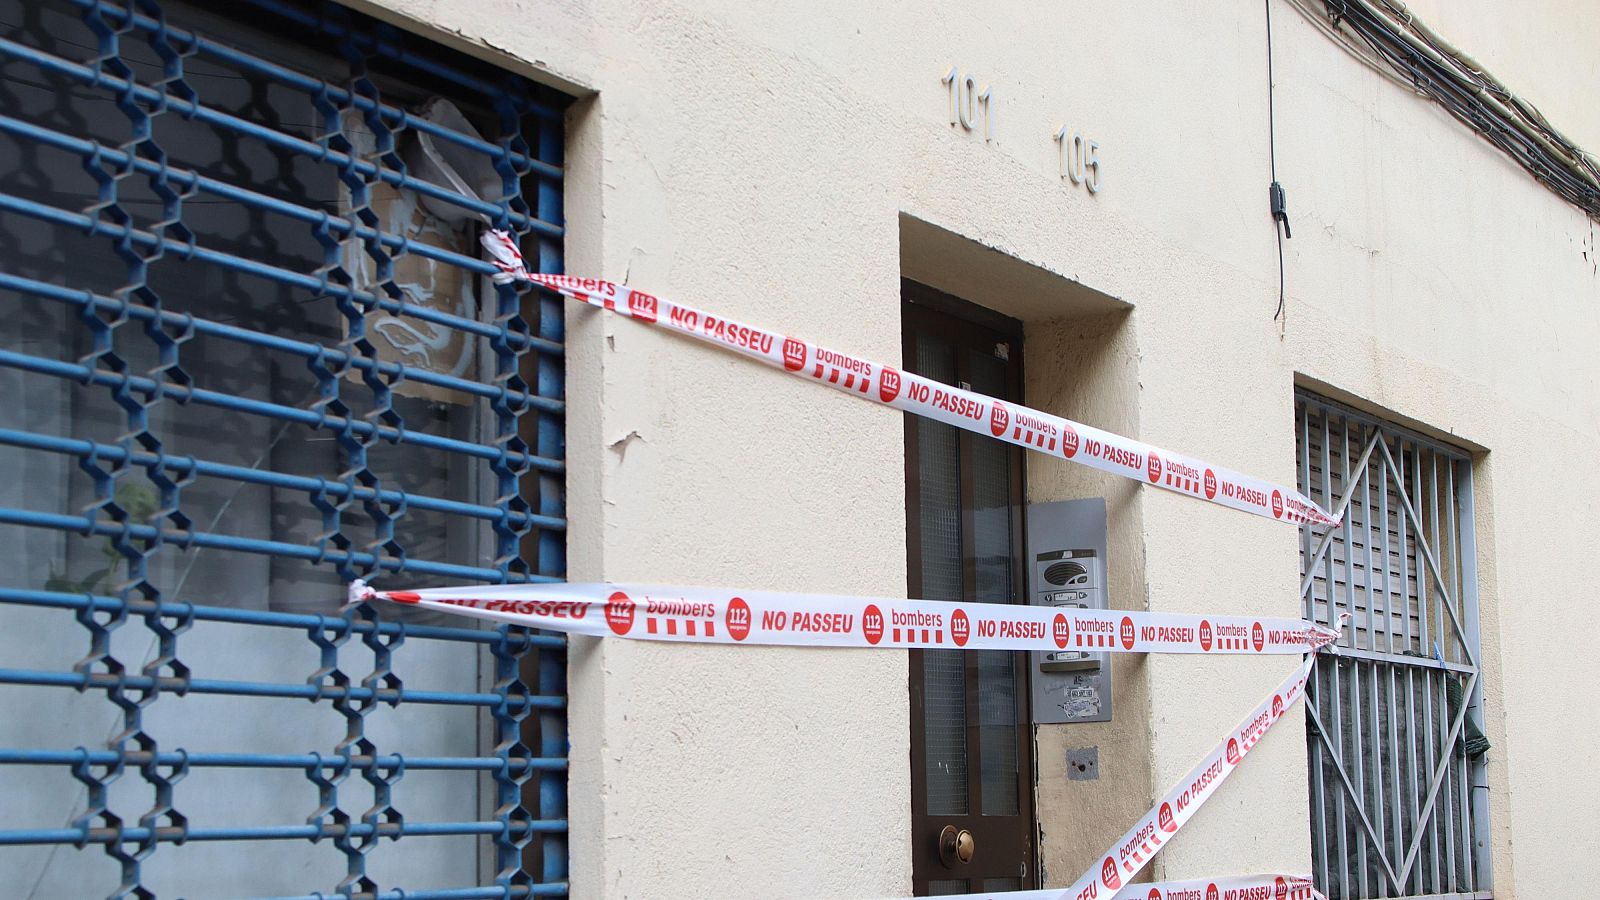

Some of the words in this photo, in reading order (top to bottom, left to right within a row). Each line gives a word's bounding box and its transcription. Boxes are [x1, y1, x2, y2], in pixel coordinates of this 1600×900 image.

[941, 65, 993, 142] 101
[1053, 124, 1104, 195] 105
[632, 293, 654, 314] 112
[670, 305, 698, 332] NO
[703, 322, 774, 354] PASSEU
[786, 341, 804, 360] 112
[816, 347, 872, 376] bombers
[882, 372, 898, 390] 112
[907, 381, 930, 403] NO
[932, 388, 985, 421] PASSEU
[993, 408, 1007, 424] 112
[1015, 410, 1057, 436] bombers
[1065, 431, 1077, 445] 112
[1084, 439, 1101, 457] NO
[1102, 443, 1143, 470] PASSEU
[1166, 461, 1199, 480] bombers
[1221, 480, 1234, 498] NO
[1236, 486, 1268, 508] PASSEU
[609, 602, 631, 617] 112
[646, 596, 716, 618] bombers
[729, 607, 748, 625] 112
[762, 610, 787, 631] NO
[791, 611, 854, 633] PASSEU
[866, 614, 881, 629] 112
[892, 608, 943, 627] bombers
[953, 618, 967, 632] 112
[977, 620, 996, 638] NO
[999, 620, 1047, 639] PASSEU
[1055, 622, 1067, 635] 112
[1075, 617, 1114, 633] bombers
[1122, 625, 1133, 637] 112
[1141, 626, 1155, 642] NO
[1158, 626, 1194, 643] PASSEU
[1216, 623, 1248, 637] bombers
[1268, 630, 1281, 644] NO
[1119, 821, 1155, 861] bombers
[1176, 790, 1190, 813] NO
[1191, 757, 1223, 798] PASSEU
[1240, 710, 1269, 743] bombers
[1167, 888, 1201, 900] bombers
[1224, 889, 1237, 900] NO
[1240, 886, 1272, 900] PASSEU
